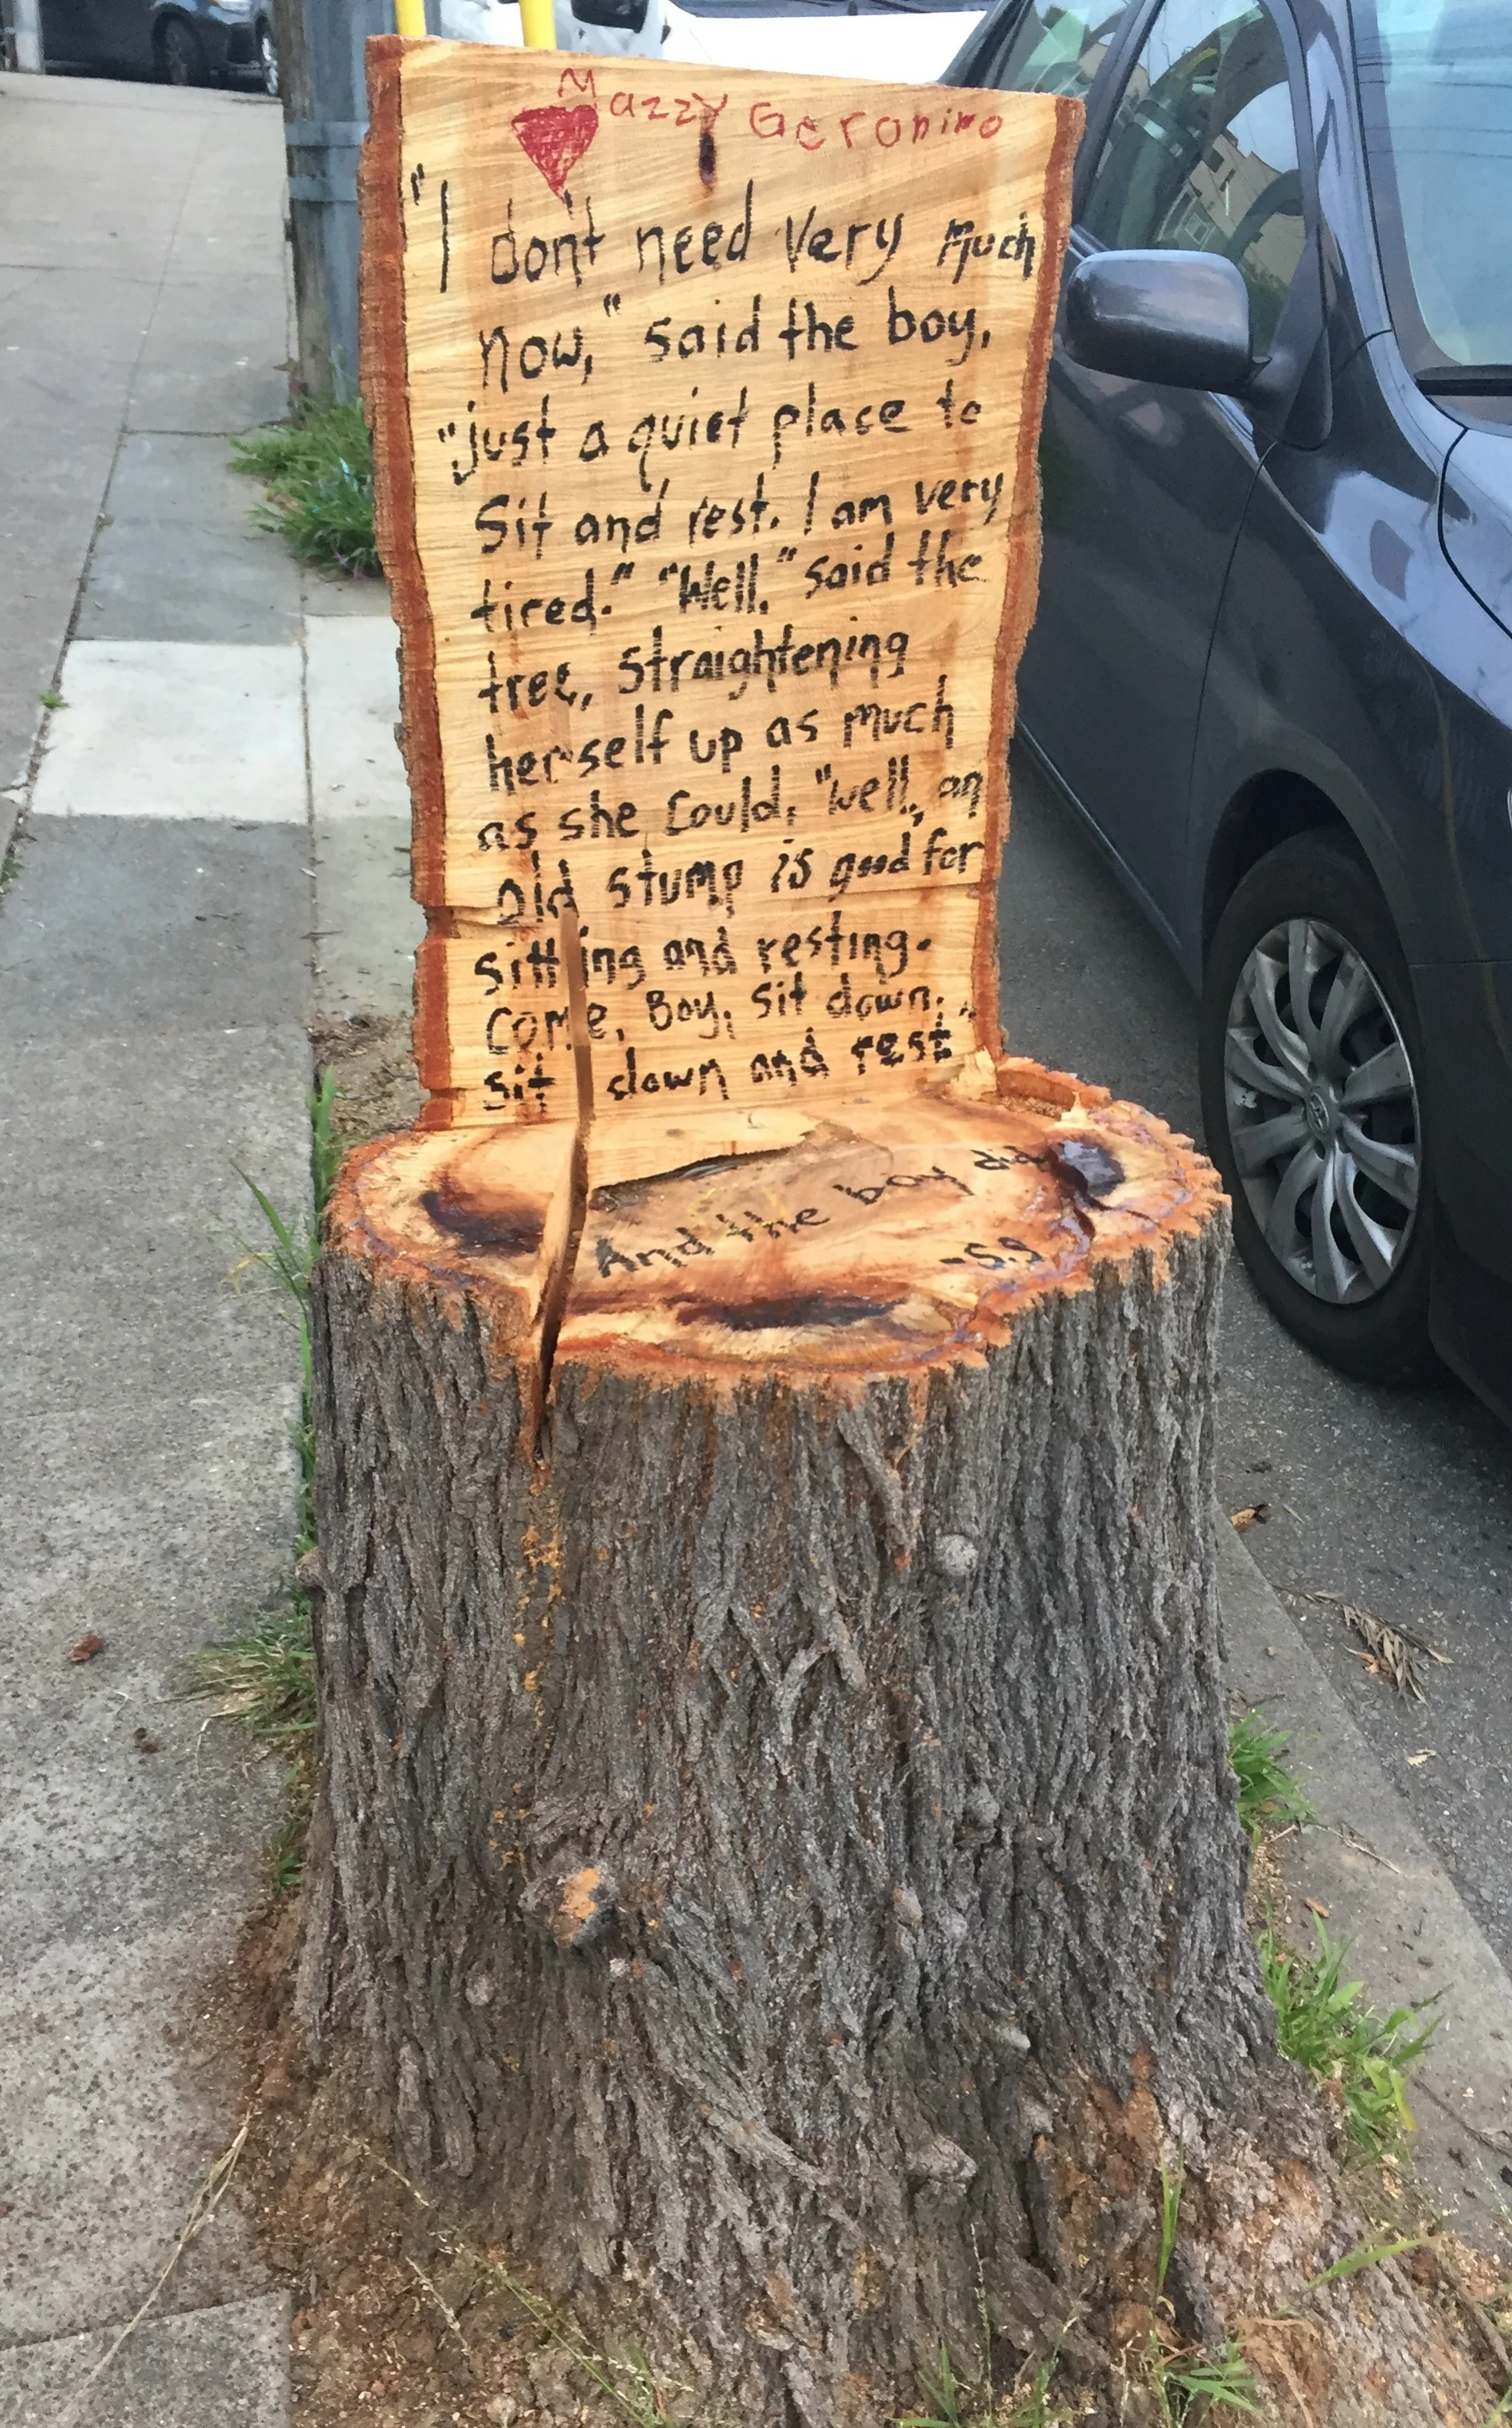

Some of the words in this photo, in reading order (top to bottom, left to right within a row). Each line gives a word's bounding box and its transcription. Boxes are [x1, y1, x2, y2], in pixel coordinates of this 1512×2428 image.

[637, 178, 754, 285] need
[645, 293, 761, 363] said
[778, 297, 859, 361] the
[888, 285, 990, 367] boy,
[579, 420, 610, 462] a
[628, 386, 748, 493] quiet
[772, 381, 913, 470] place
[936, 378, 982, 430] to
[575, 478, 670, 553] and
[689, 472, 780, 548] rest.
[804, 470, 820, 536] I
[831, 494, 894, 530] am
[915, 472, 1003, 526] very
[907, 529, 986, 589] the
[479, 651, 593, 711] tree,
[689, 726, 743, 774] up
[766, 708, 819, 748] as
[477, 811, 538, 852] as
[558, 789, 639, 841] she
[827, 831, 911, 903] good
[923, 826, 985, 876] for
[663, 925, 738, 977] and
[758, 910, 932, 985] resting.
[607, 1046, 730, 1101] down
[750, 1027, 831, 1088] and
[595, 1226, 715, 1279] And
[715, 1207, 831, 1243] the
[833, 1166, 975, 1207] boy
